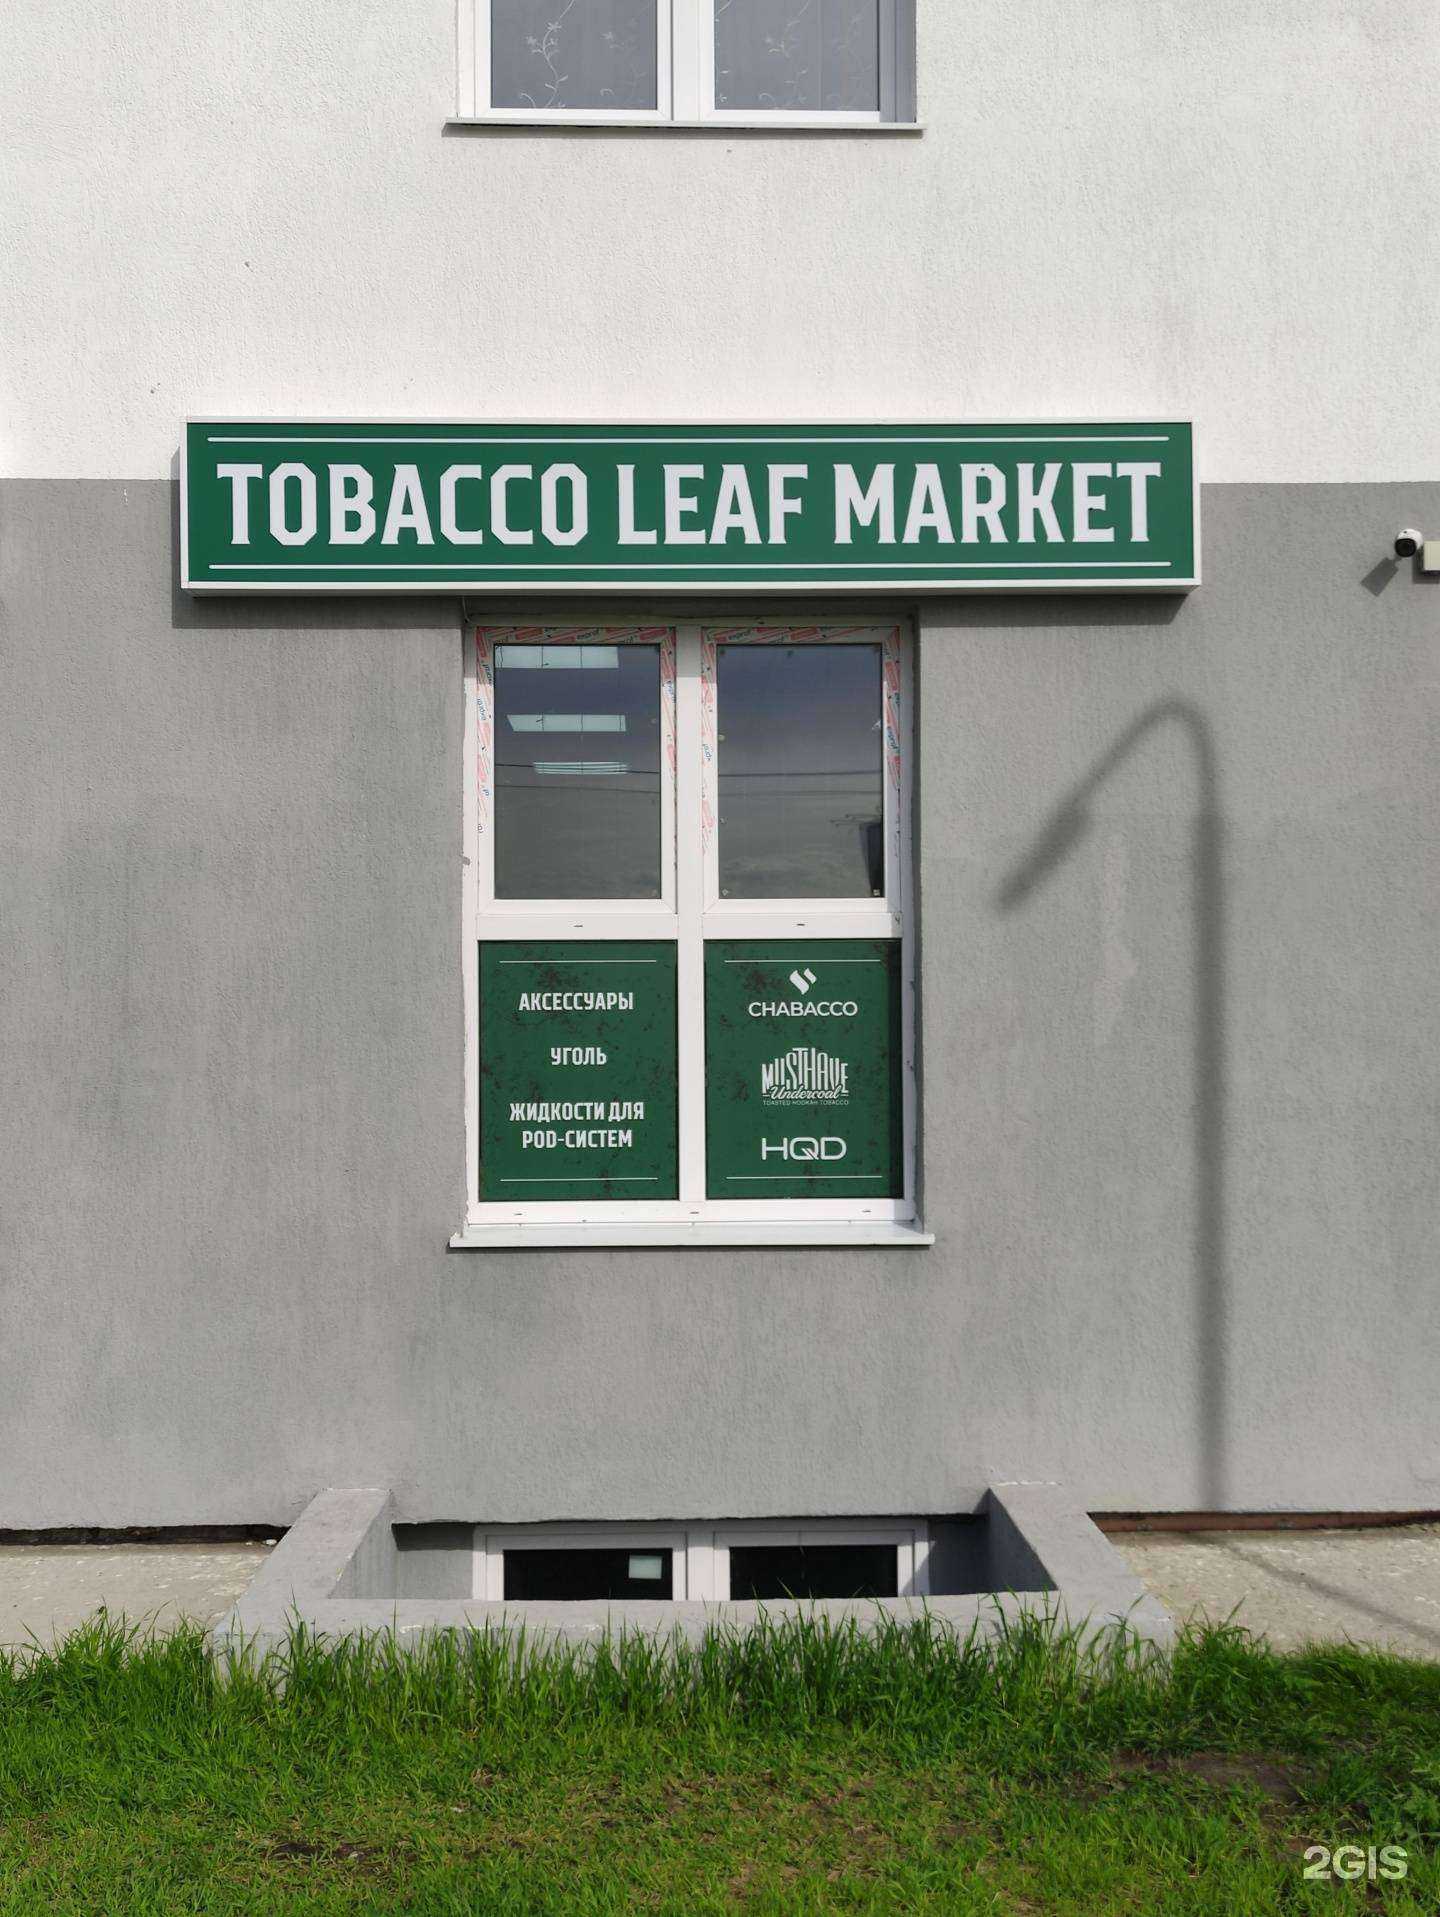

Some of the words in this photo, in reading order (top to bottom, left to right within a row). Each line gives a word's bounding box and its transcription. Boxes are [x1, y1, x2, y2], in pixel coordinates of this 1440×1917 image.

[216, 462, 589, 546] TOBACCO
[616, 463, 809, 545] LEAF
[832, 461, 1162, 545] MARKET
[518, 992, 634, 1011] АКСЕССУАРЫ
[748, 1001, 858, 1017] CHABACCO
[550, 1046, 607, 1066] УГОЛЬ
[761, 1047, 849, 1093] MUSTHAVE
[770, 1085, 842, 1100] Undercoal
[509, 1102, 605, 1123] ЖИДКОСТИ
[607, 1101, 645, 1122] ДЛЯ
[522, 1129, 633, 1149] POD-СИСТЕМ
[761, 1136, 847, 1161] HQD
